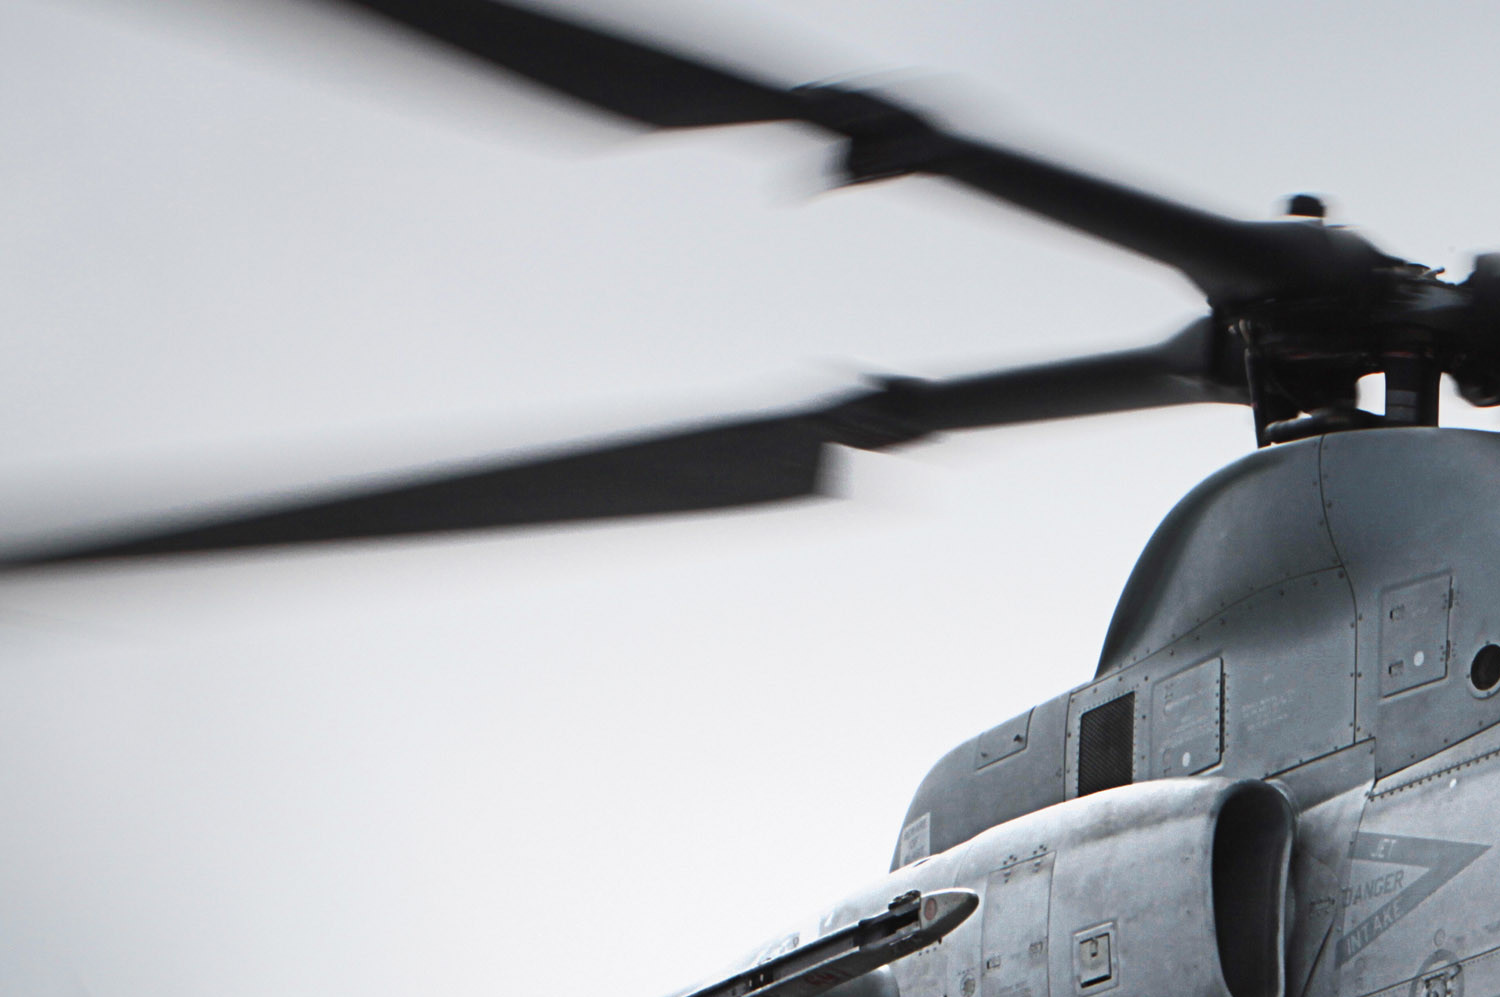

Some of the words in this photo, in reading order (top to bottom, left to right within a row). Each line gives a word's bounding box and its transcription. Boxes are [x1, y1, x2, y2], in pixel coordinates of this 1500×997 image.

[1370, 838, 1398, 859] JET
[1342, 869, 1405, 908] DANGER
[1346, 899, 1404, 956] INTAKE
